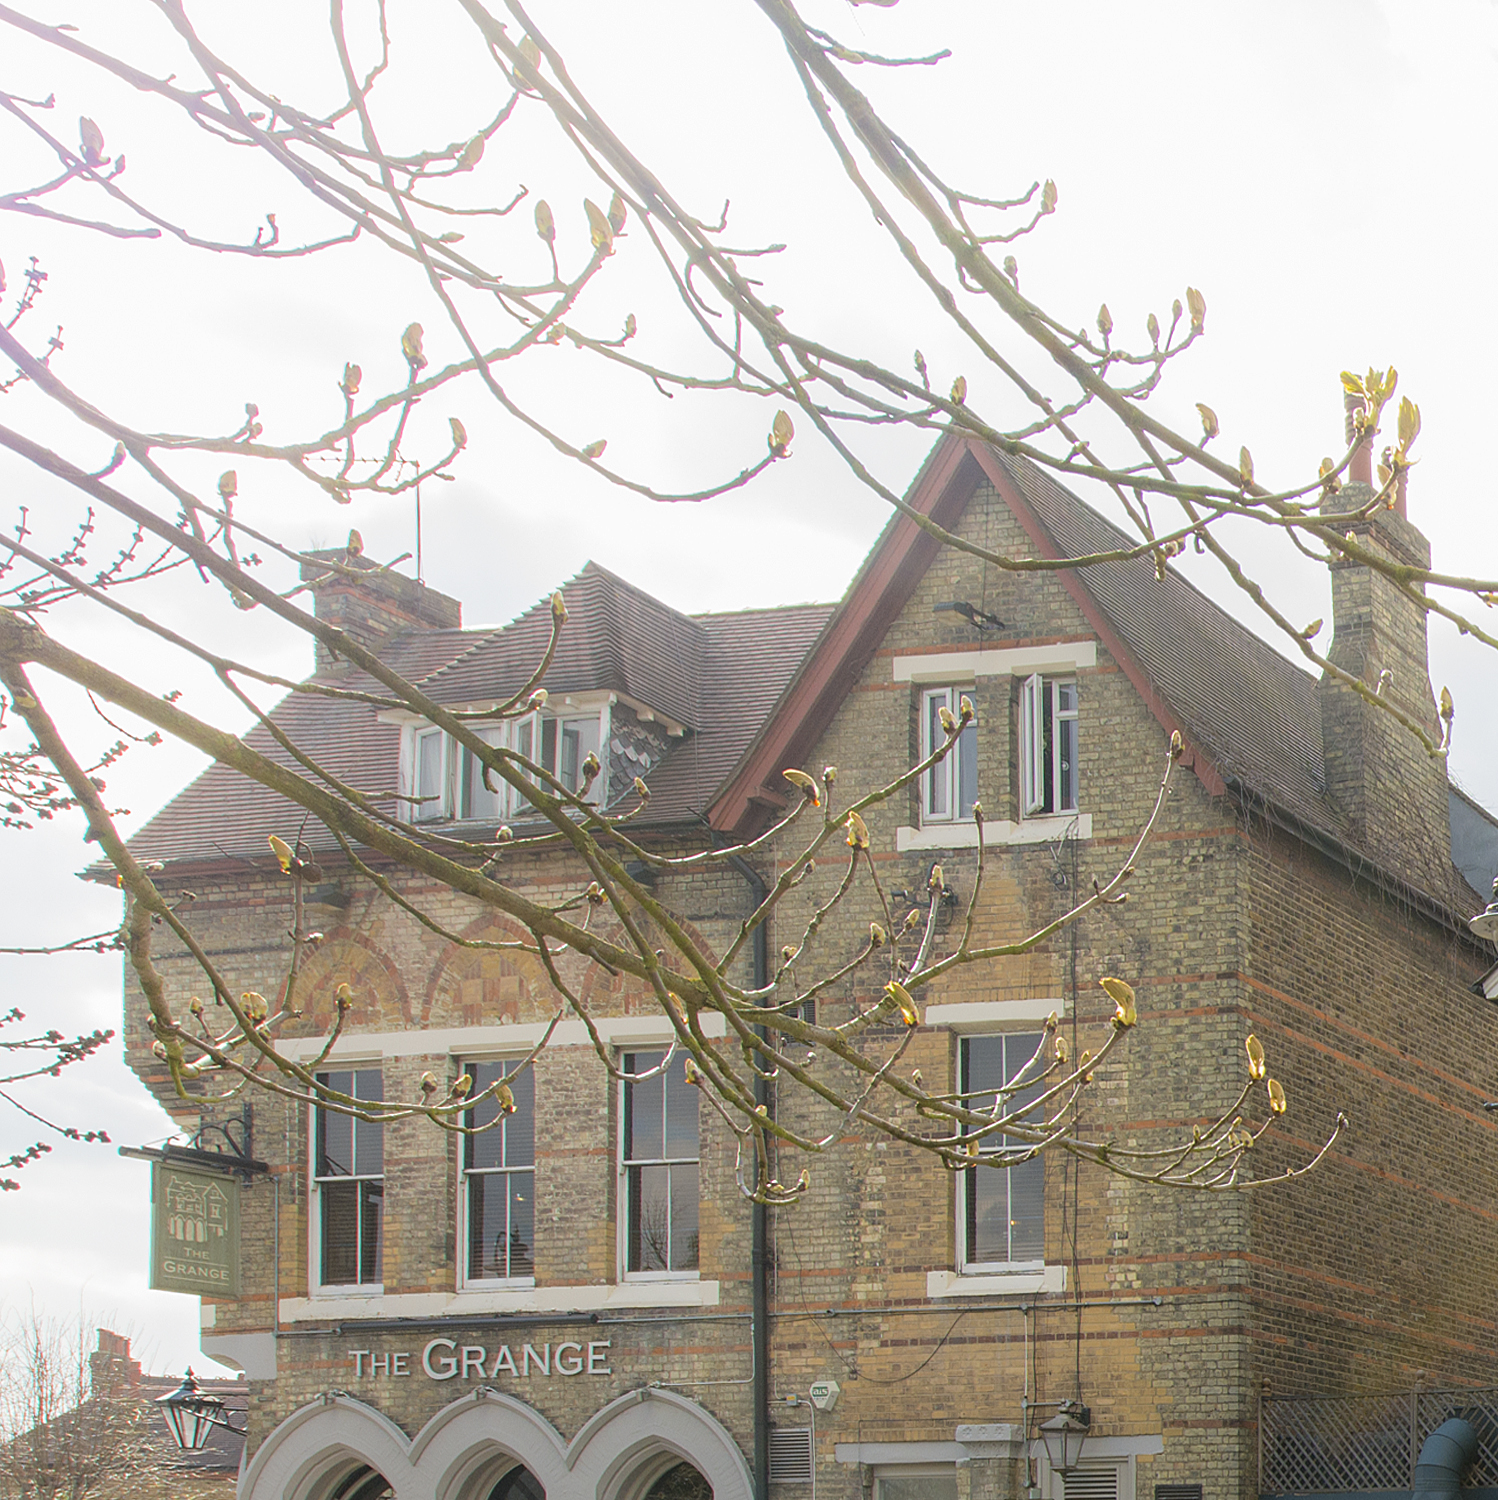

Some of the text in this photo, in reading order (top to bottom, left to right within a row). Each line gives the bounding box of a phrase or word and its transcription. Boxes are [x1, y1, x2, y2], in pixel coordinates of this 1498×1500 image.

[184, 1247, 210, 1260] THE
[162, 1260, 230, 1280] GRANGE
[348, 1338, 612, 1381] THE GRANGE
